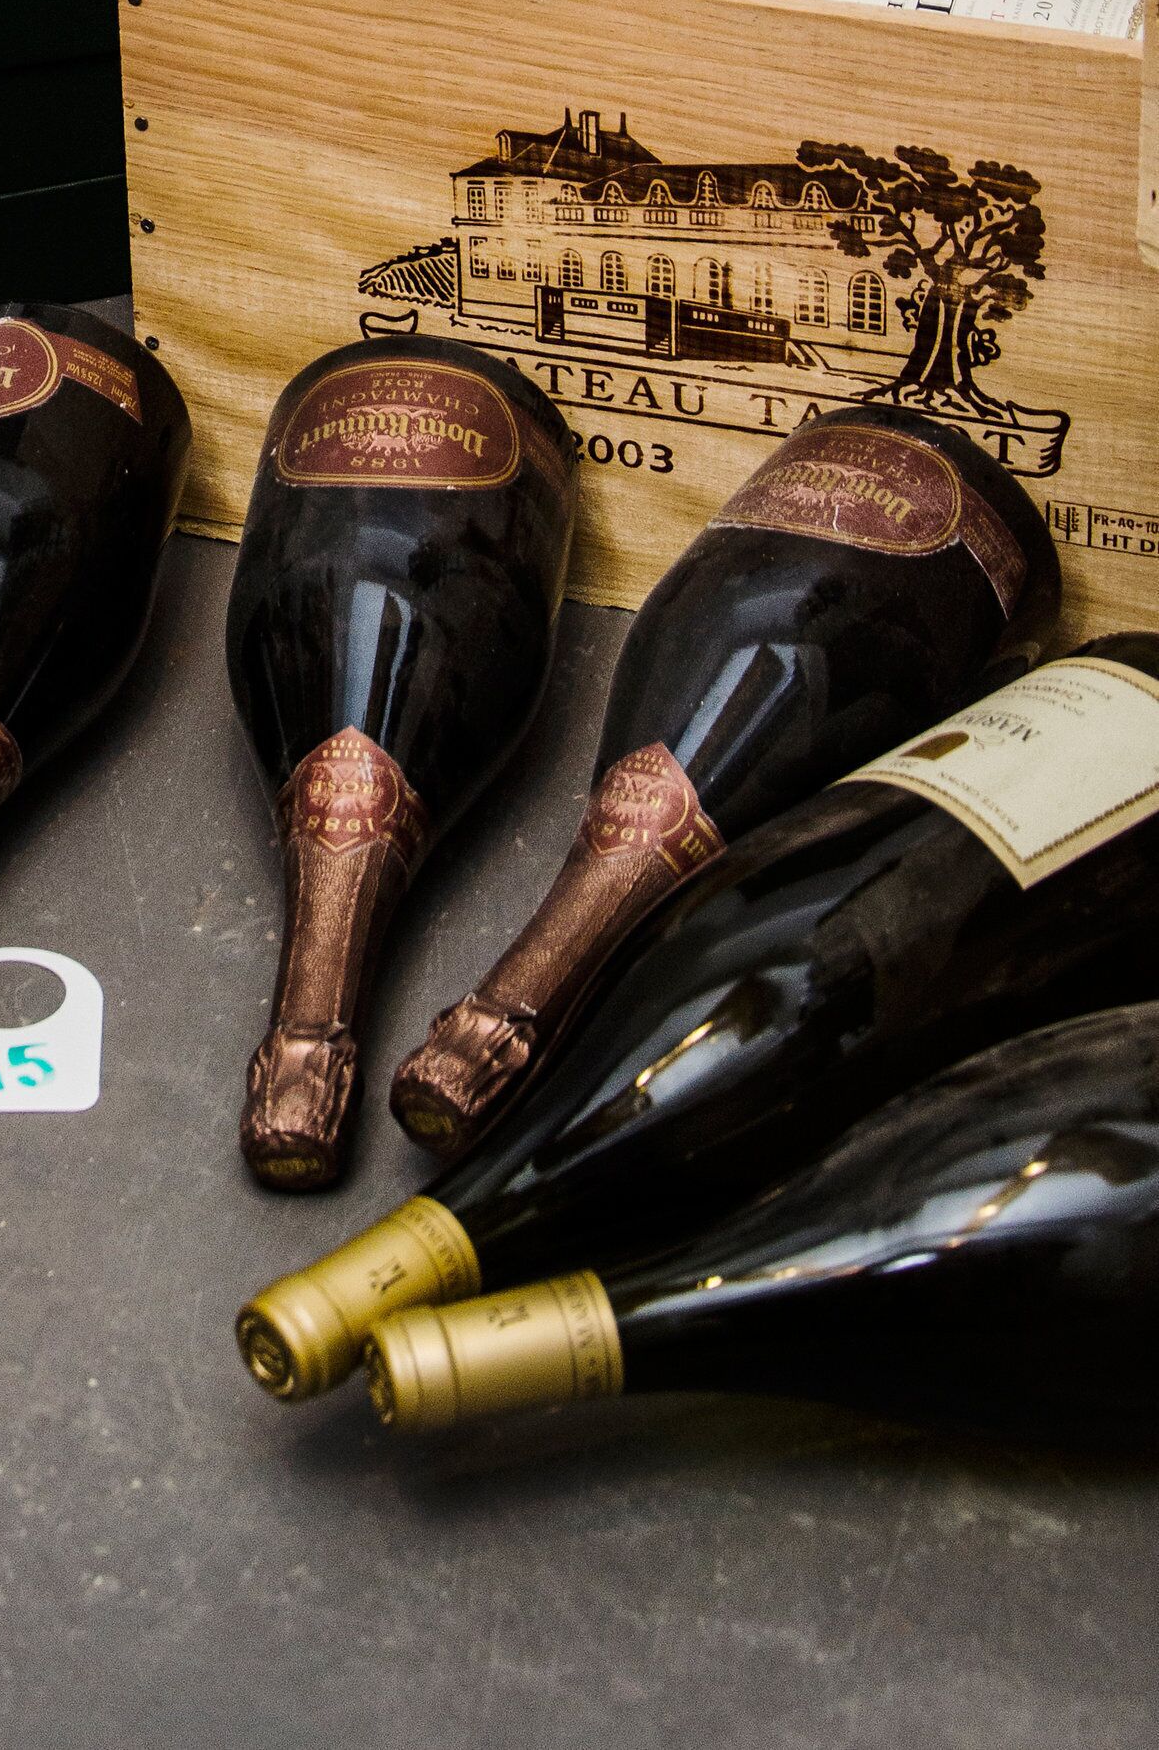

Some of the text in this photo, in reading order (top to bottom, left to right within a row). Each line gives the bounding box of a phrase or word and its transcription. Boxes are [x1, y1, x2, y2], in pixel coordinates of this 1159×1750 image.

[319, 389, 480, 416] CHAMPAGNE
[298, 413, 490, 458] Dom Ruinart
[349, 456, 422, 470] 1988
[1094, 513, 1159, 534] FR-AQ-10
[1103, 533, 1133, 549] HT
[307, 815, 375, 833] 1988
